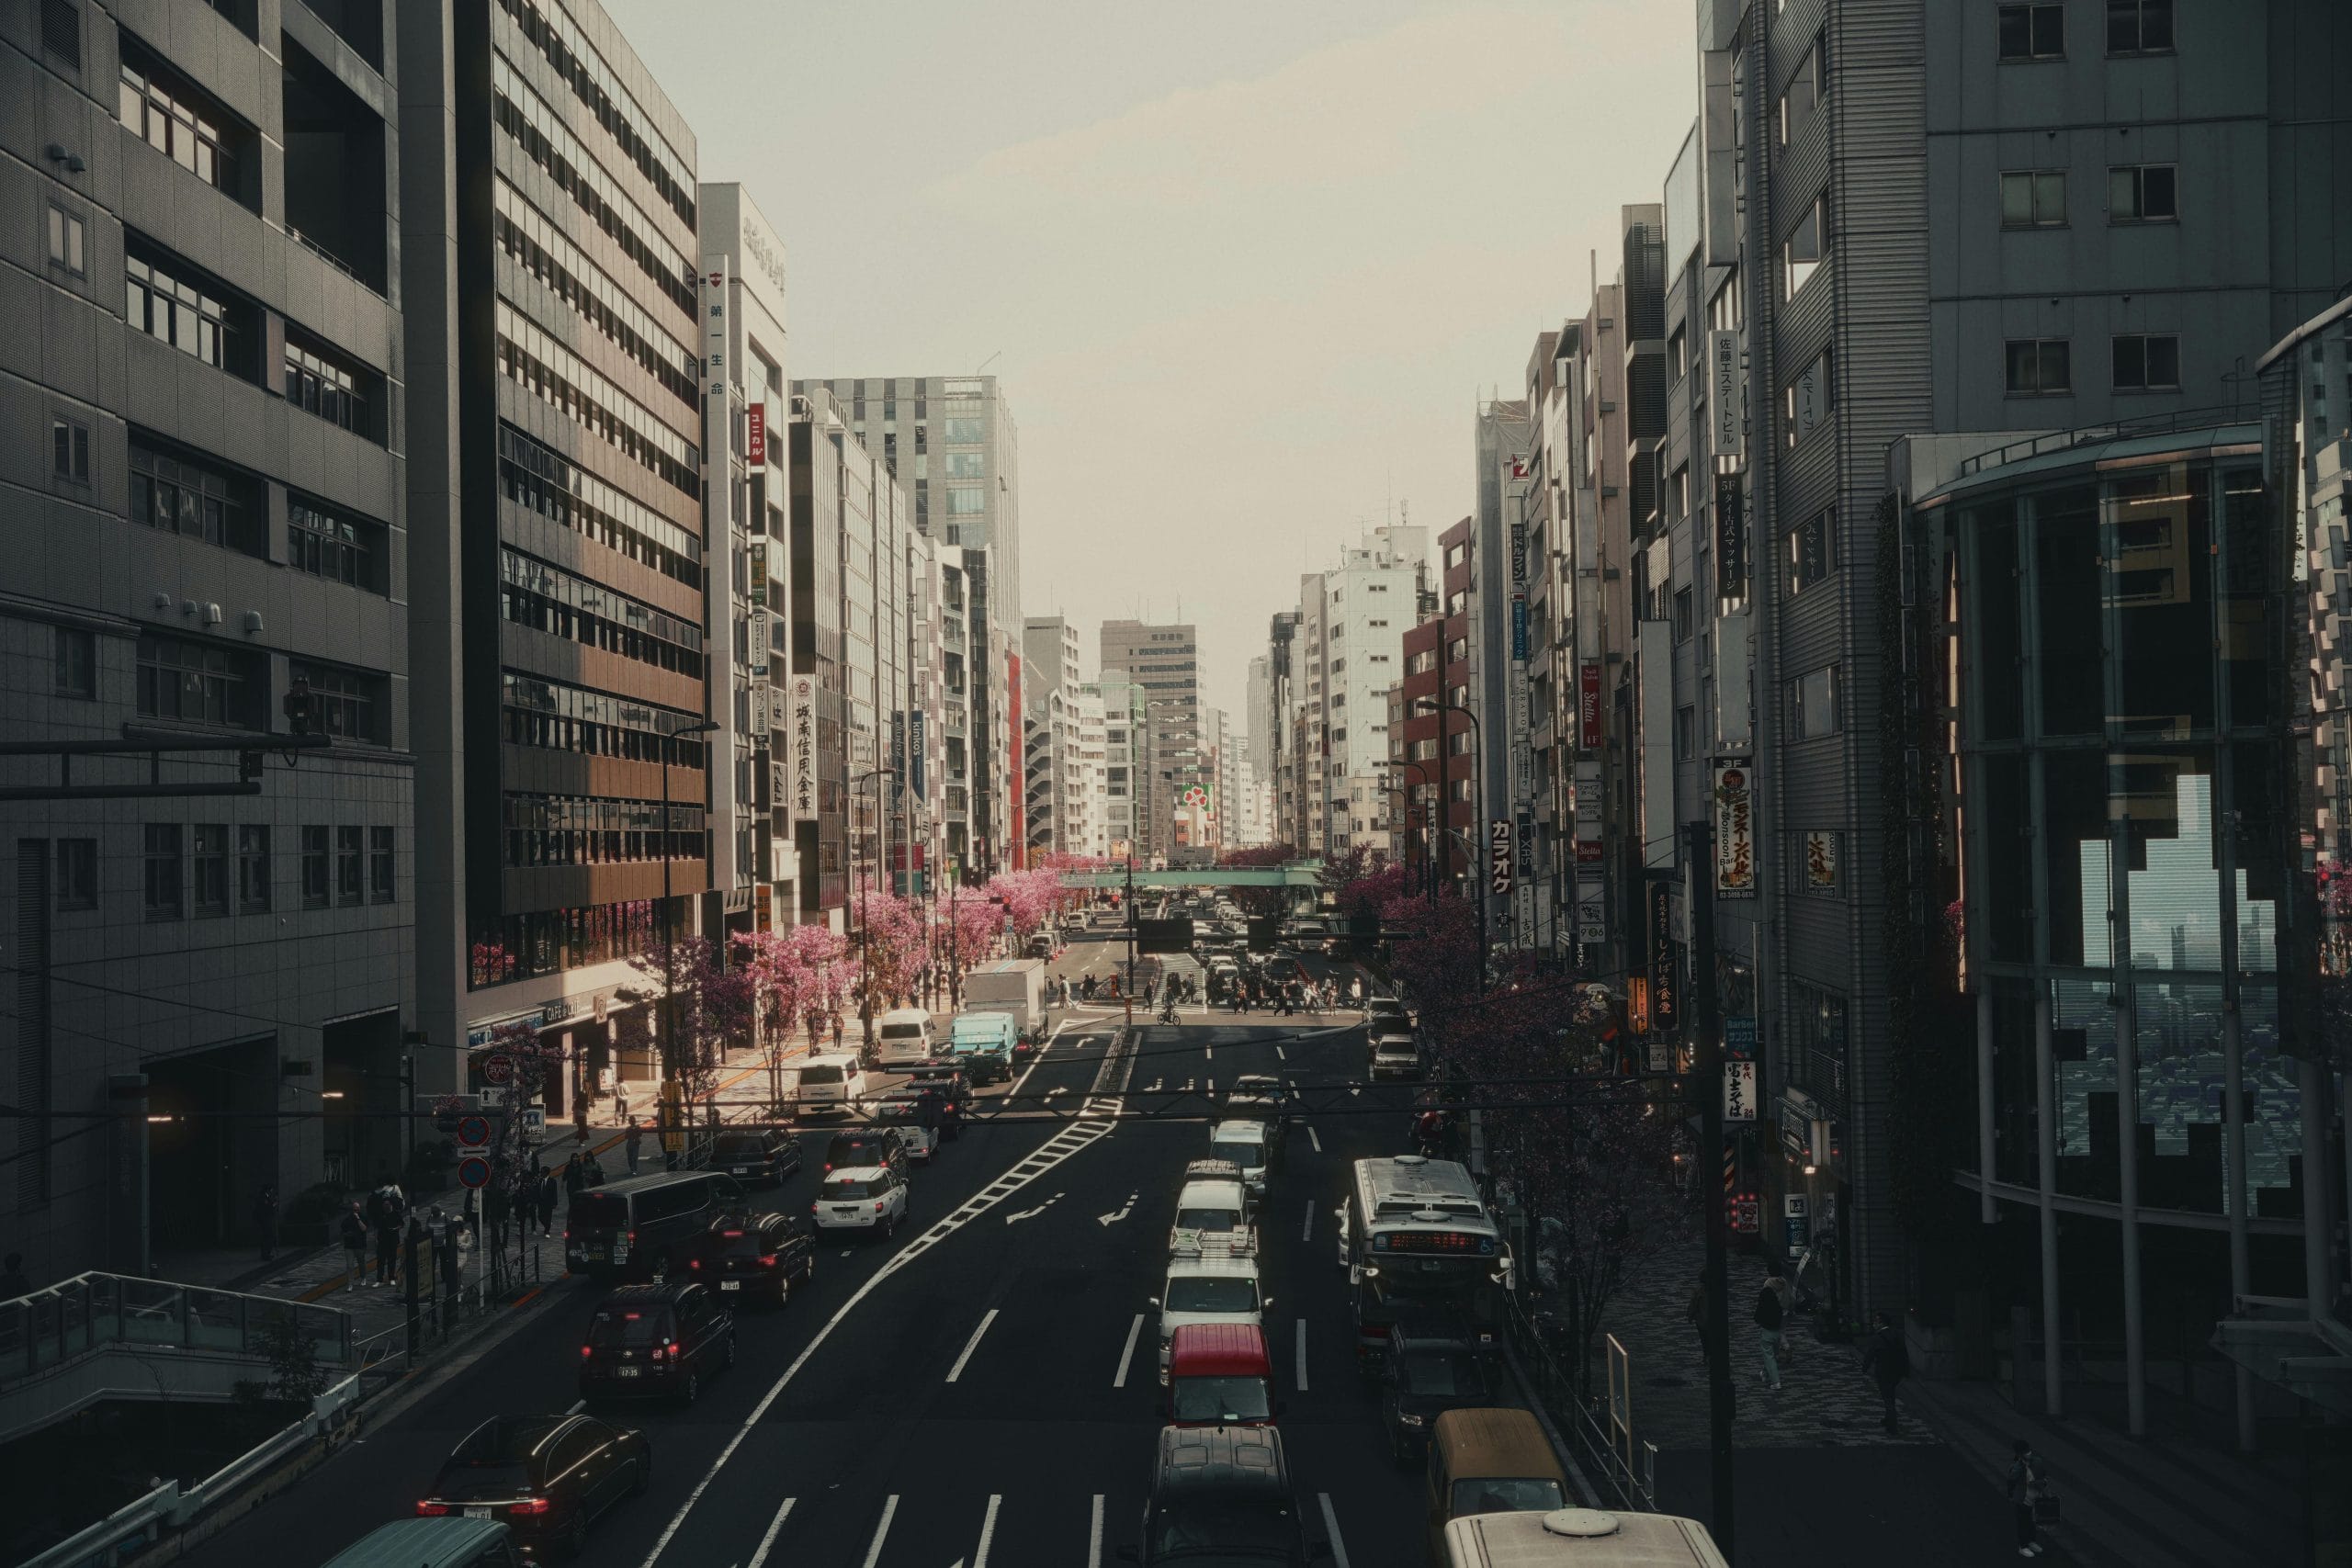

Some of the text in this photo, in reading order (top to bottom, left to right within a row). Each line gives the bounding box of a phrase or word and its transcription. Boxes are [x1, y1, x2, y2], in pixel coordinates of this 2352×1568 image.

[710, 305, 723, 395] 第一生命
[1720, 338, 1734, 445] 佐藤エステートビル
[1721, 480, 1736, 590] 5F タイ古式マッサージ
[797, 703, 813, 816] 城南信用金庫
[1492, 821, 1510, 894] カラオケ
[1657, 939, 1672, 1014] しんぱち食堂
